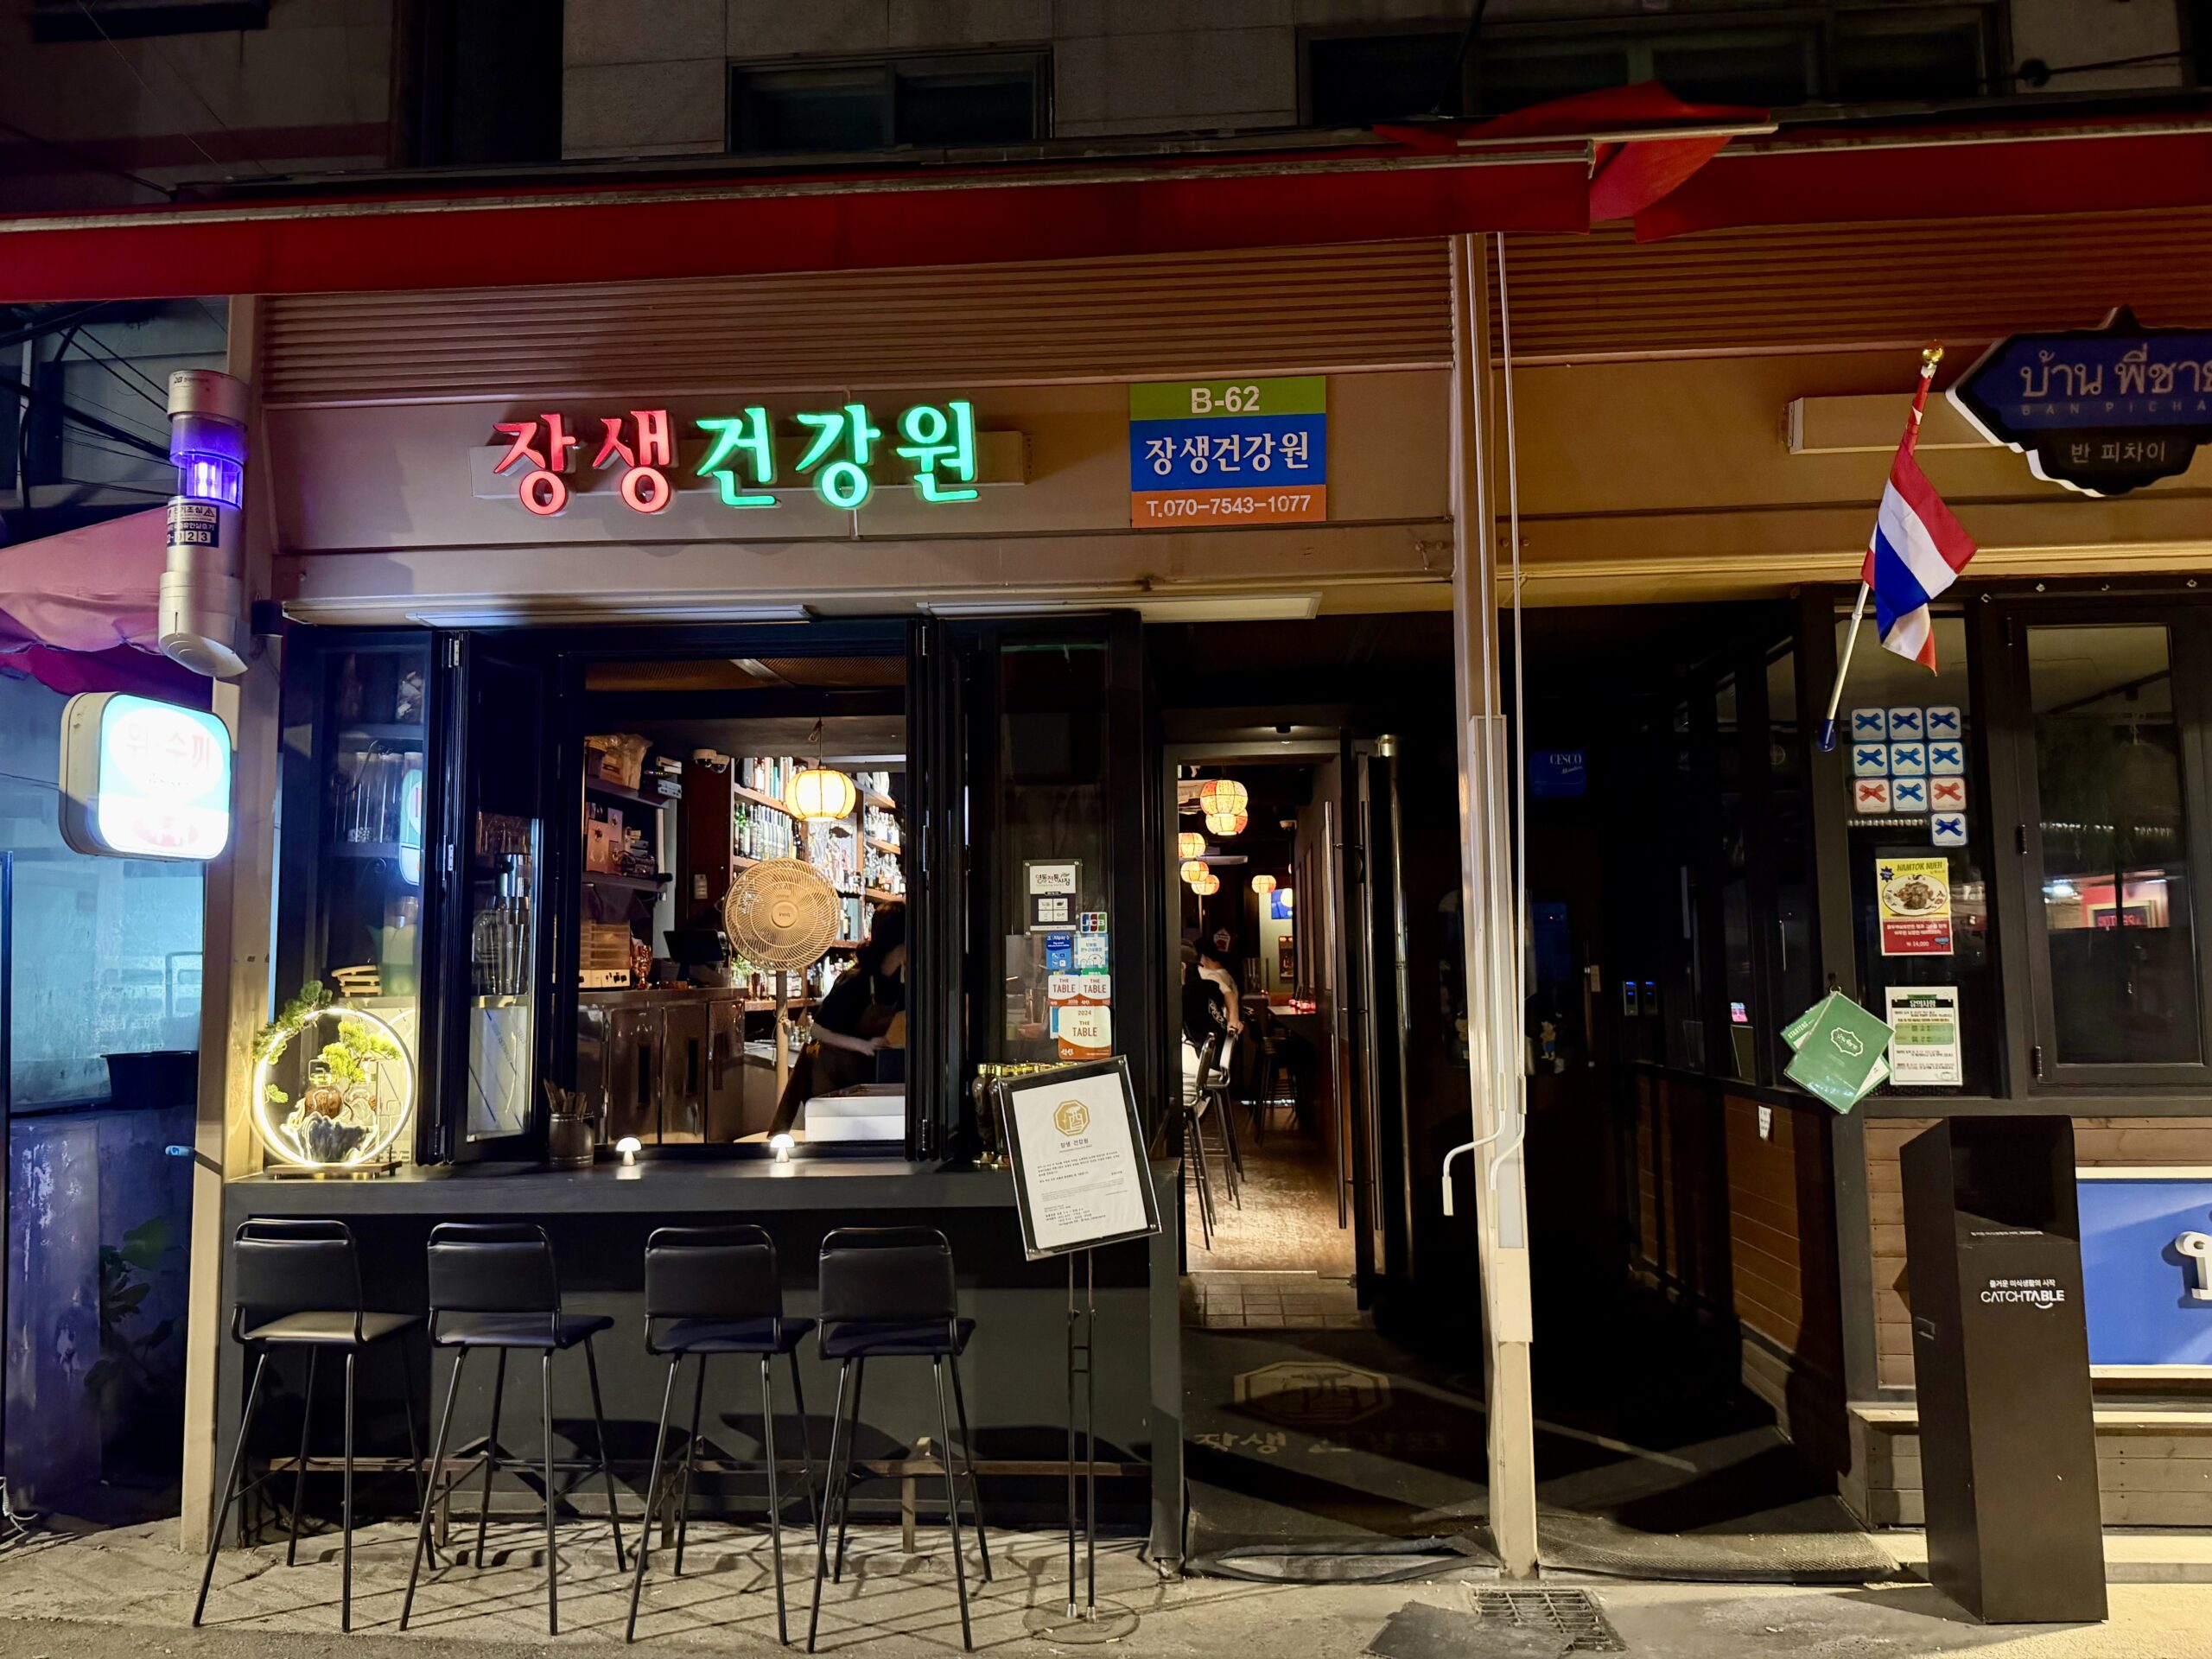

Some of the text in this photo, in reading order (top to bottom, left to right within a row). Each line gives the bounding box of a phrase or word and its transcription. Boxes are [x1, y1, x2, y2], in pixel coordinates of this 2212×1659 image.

[2019, 349, 2103, 397] บ้าน
[1191, 385, 1261, 414] B-62
[2021, 403, 2080, 416] BAN
[1144, 431, 1309, 476] 장생건강원
[2071, 442, 2165, 463] 반 피차이
[1146, 494, 1312, 518] T.070-7543-1077
[1549, 753, 1582, 766] CESCO
[1897, 863, 1925, 872] NAMTOK
[1052, 984, 1076, 994] TABLE
[1084, 984, 1107, 994] TABLE
[1072, 1027, 1098, 1037] TABLE
[1980, 1290, 2065, 1302] CATCHTABLE
